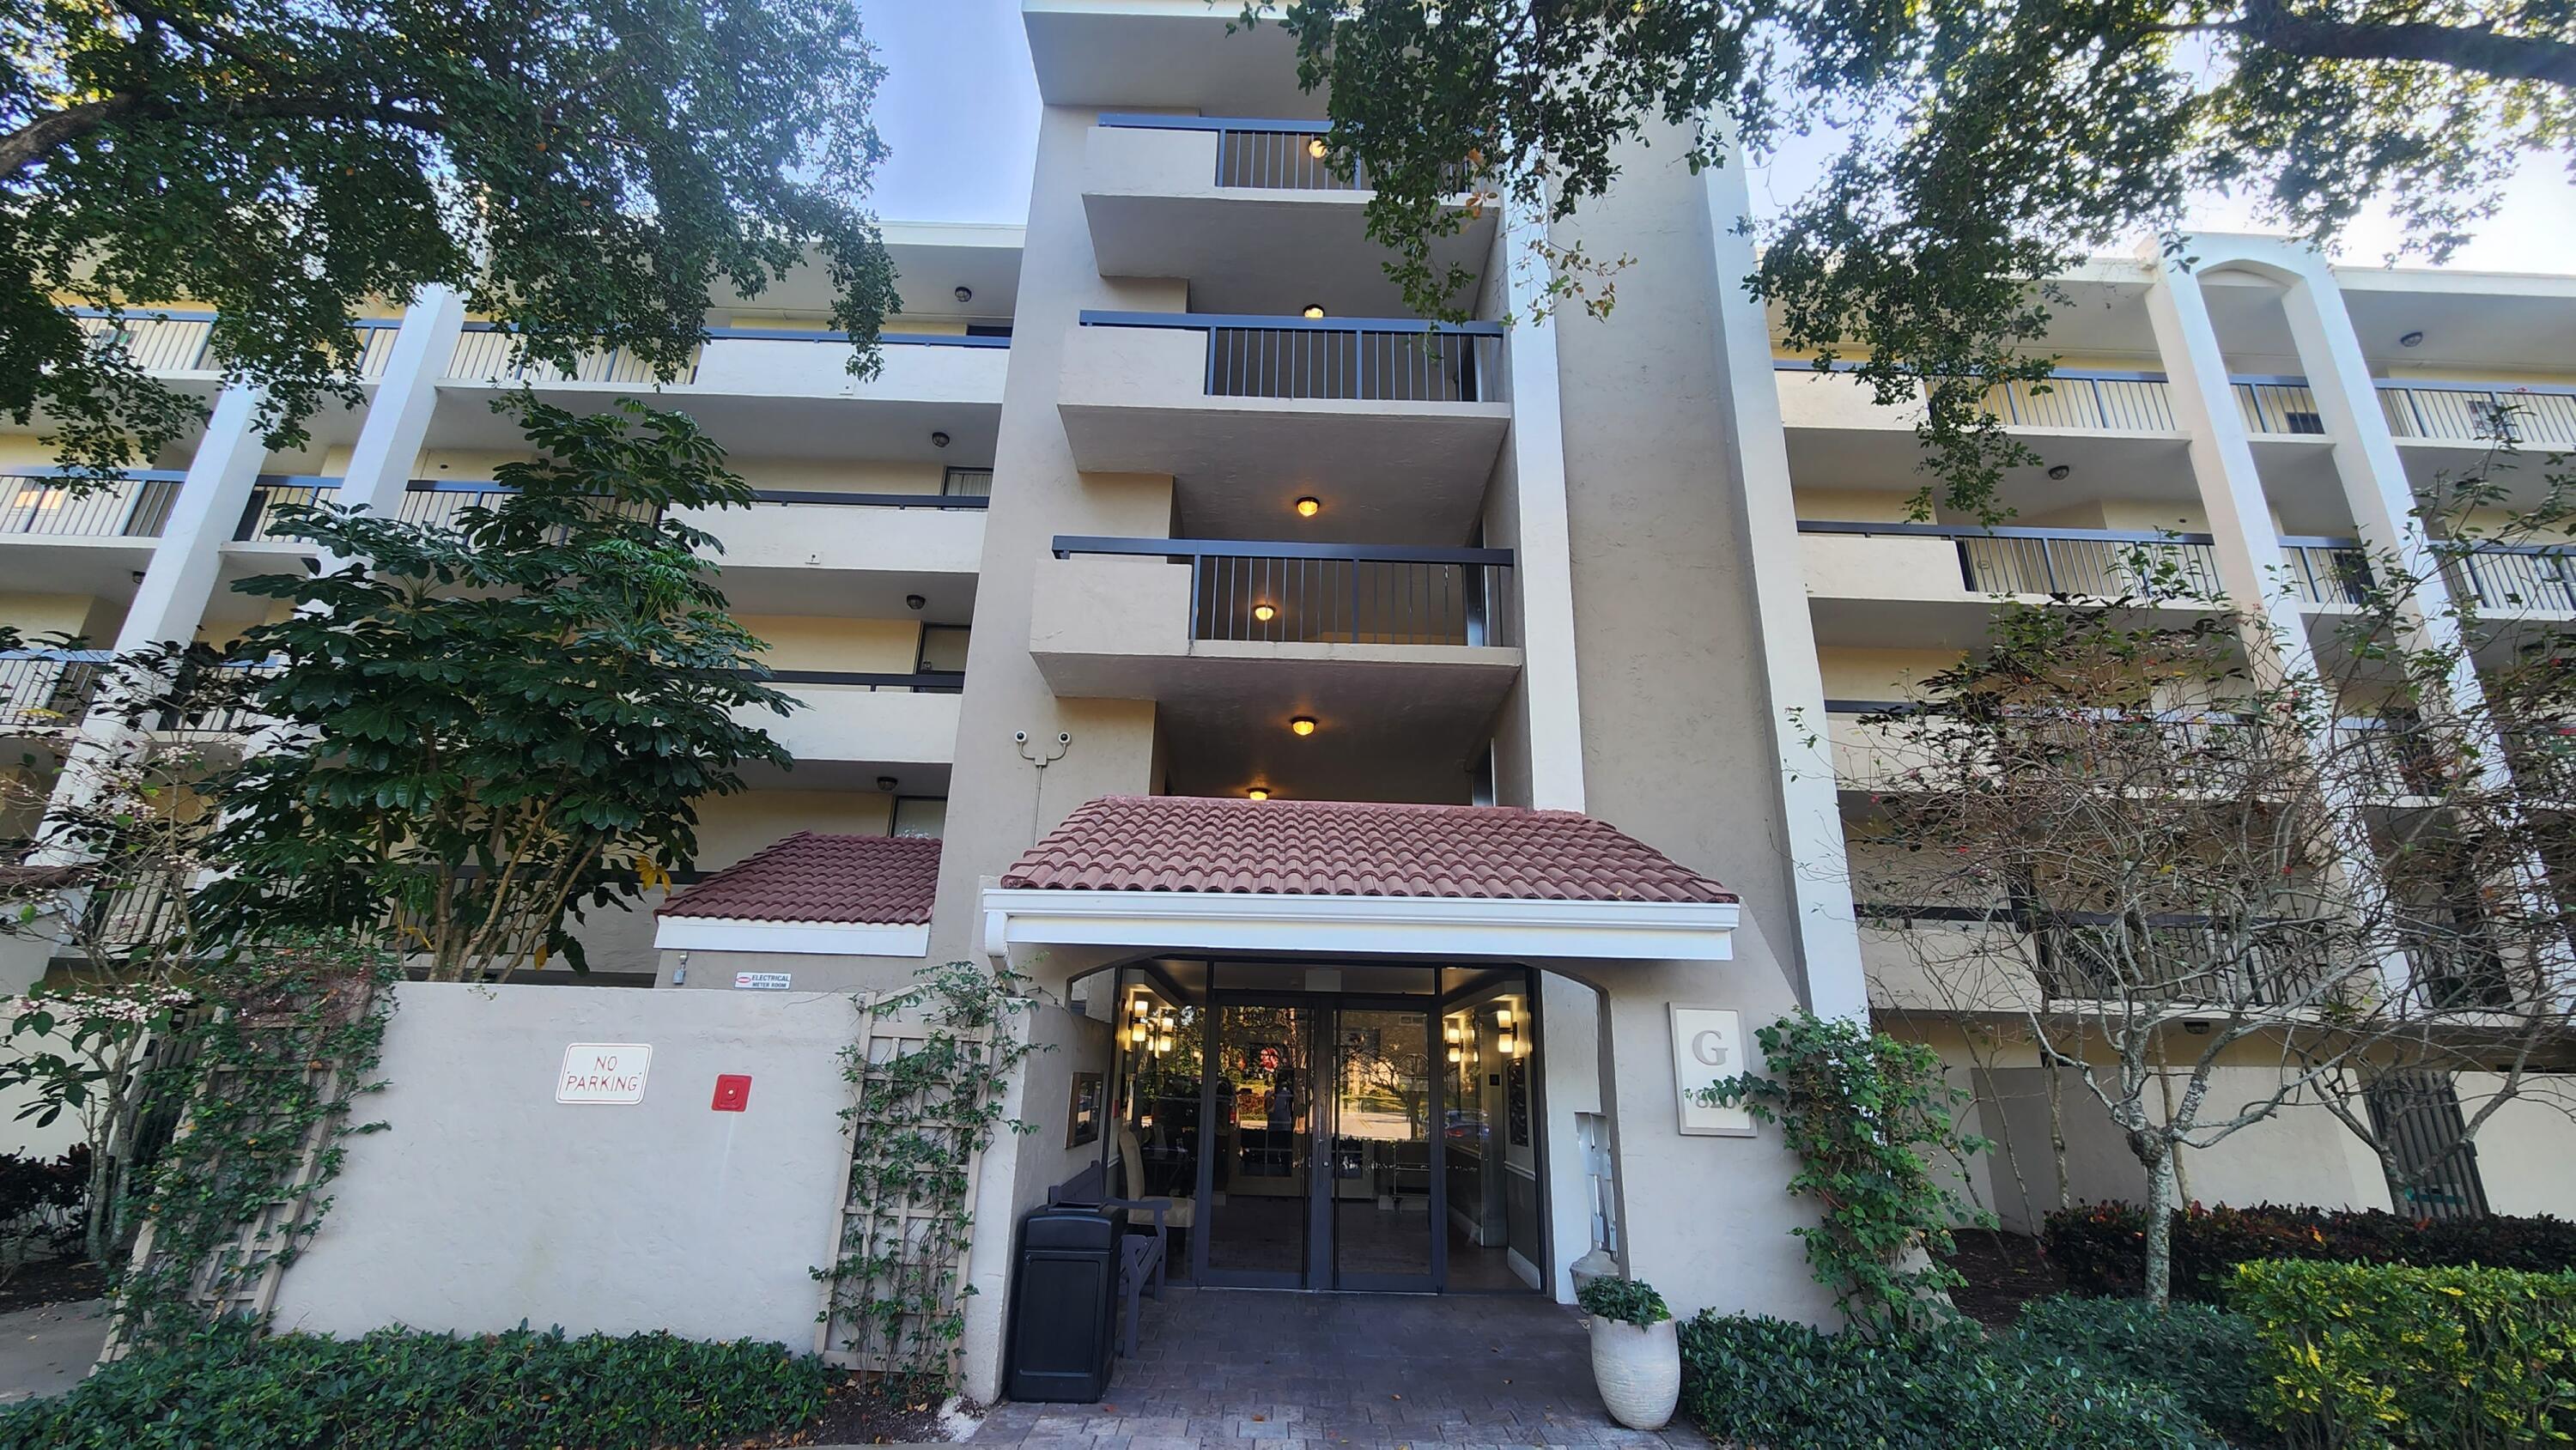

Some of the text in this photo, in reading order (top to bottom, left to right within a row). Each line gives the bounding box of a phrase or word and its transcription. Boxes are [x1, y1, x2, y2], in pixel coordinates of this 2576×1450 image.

[1692, 1030, 1728, 1065] G
[594, 1056, 617, 1071] NO
[565, 1076, 638, 1092] PARKING
